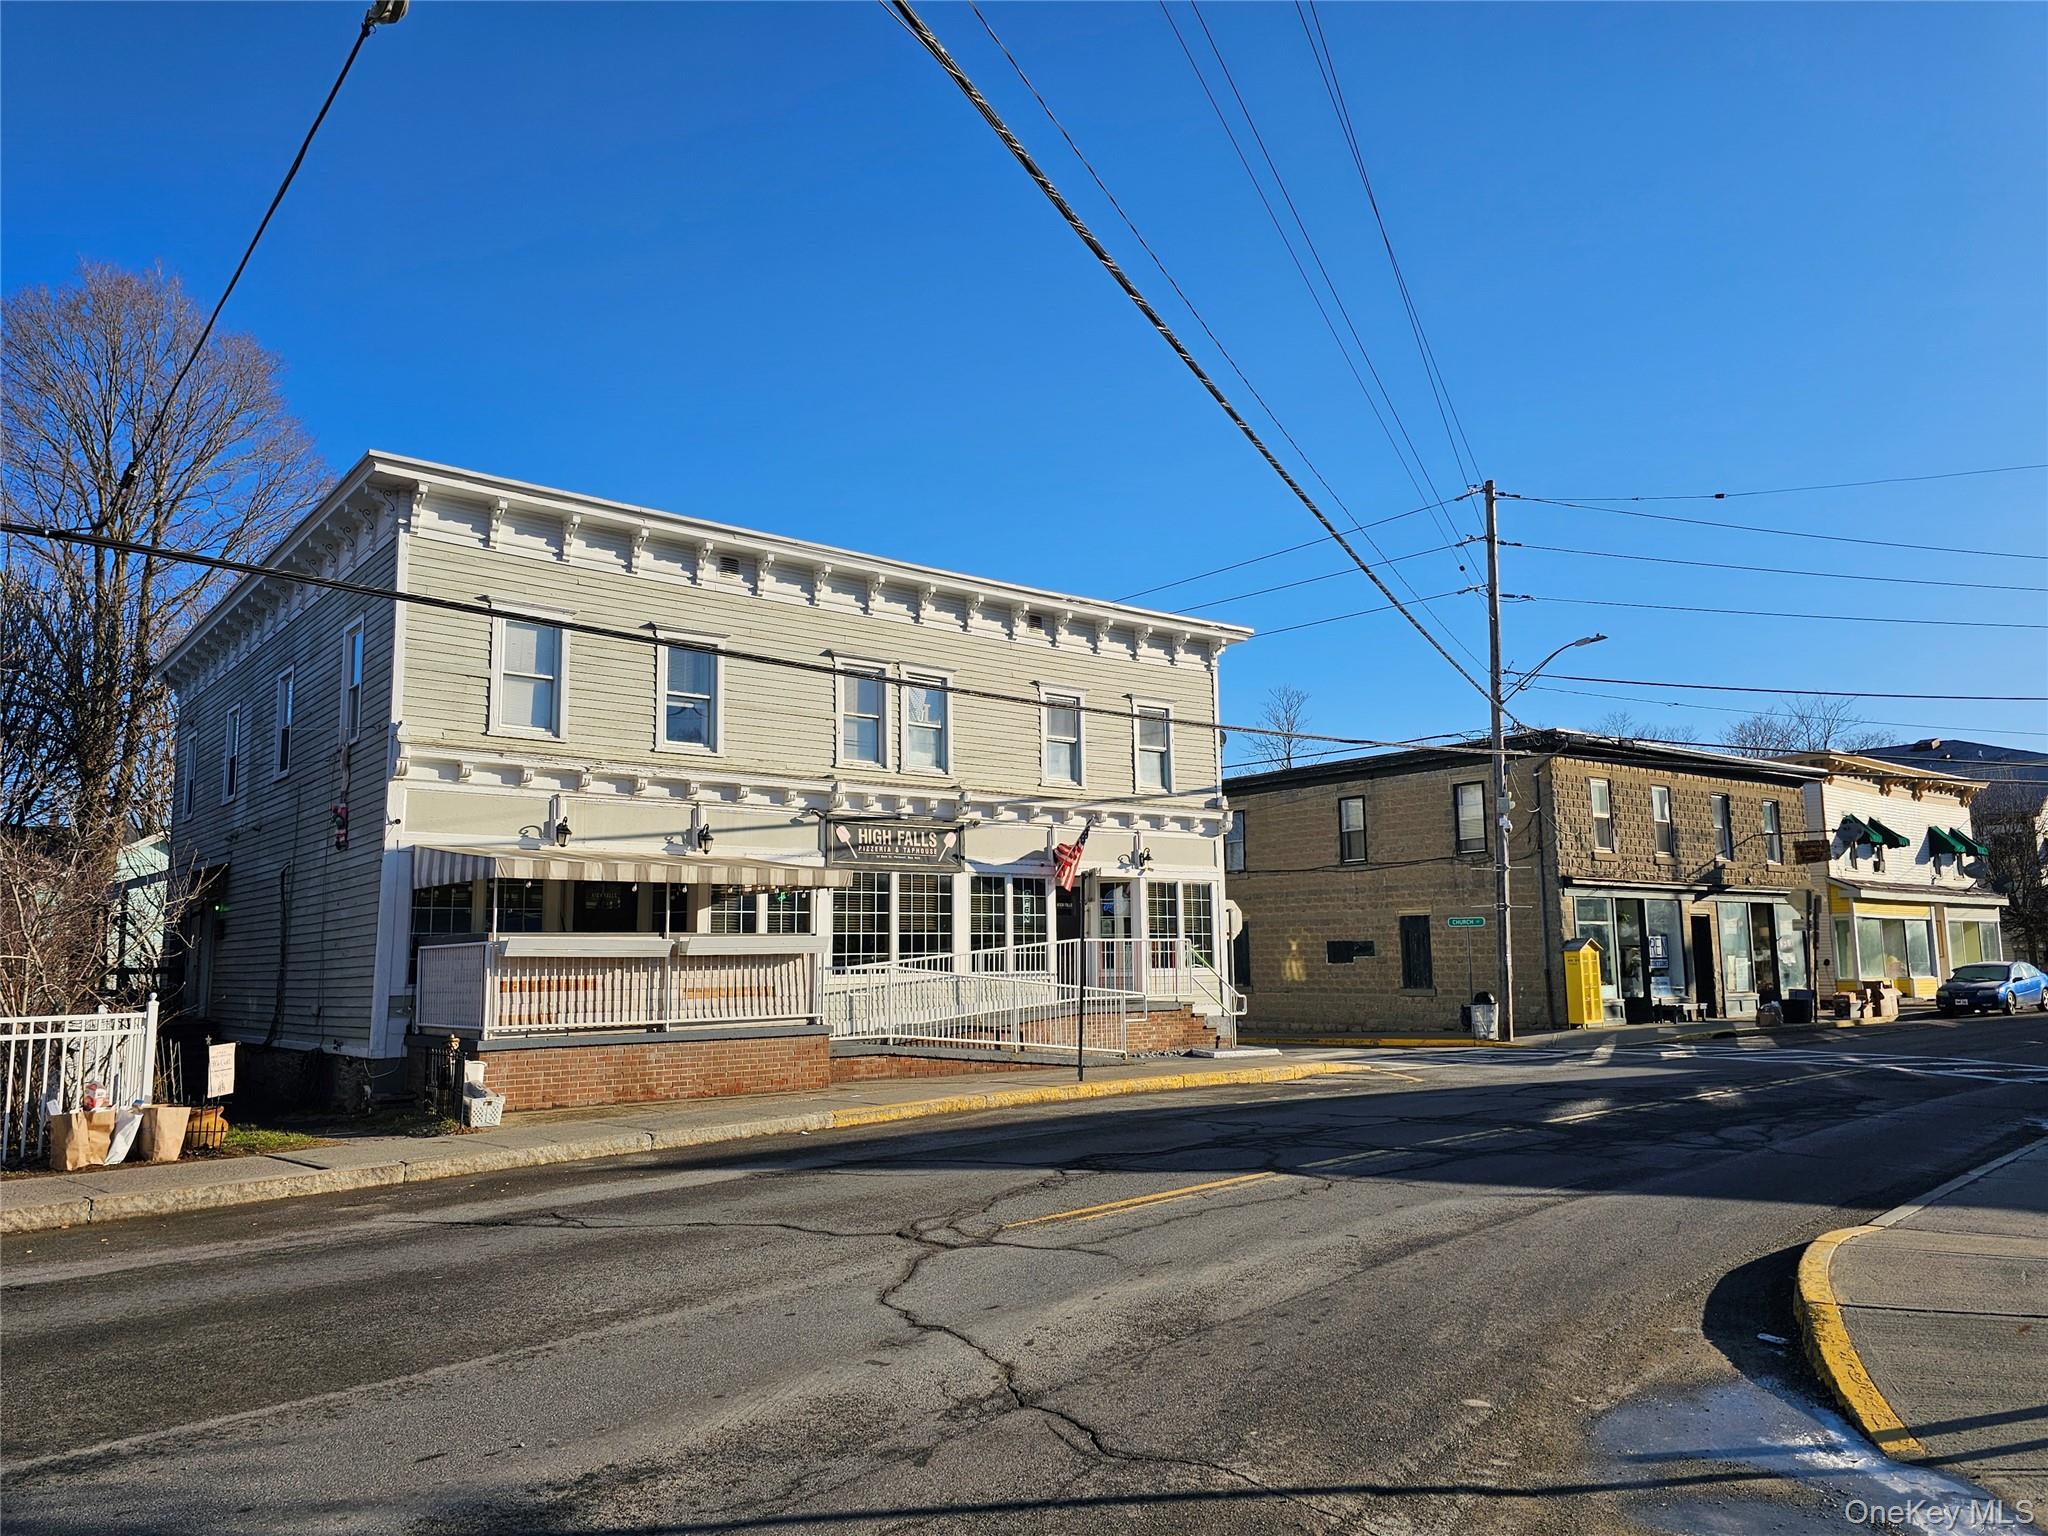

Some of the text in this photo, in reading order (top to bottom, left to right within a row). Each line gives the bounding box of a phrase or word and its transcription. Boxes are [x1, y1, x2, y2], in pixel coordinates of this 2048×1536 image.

[858, 828, 938, 848] HIGH FALLS
[858, 845, 892, 853] PIZZERIA
[903, 846, 937, 855] TAPHOUSE
